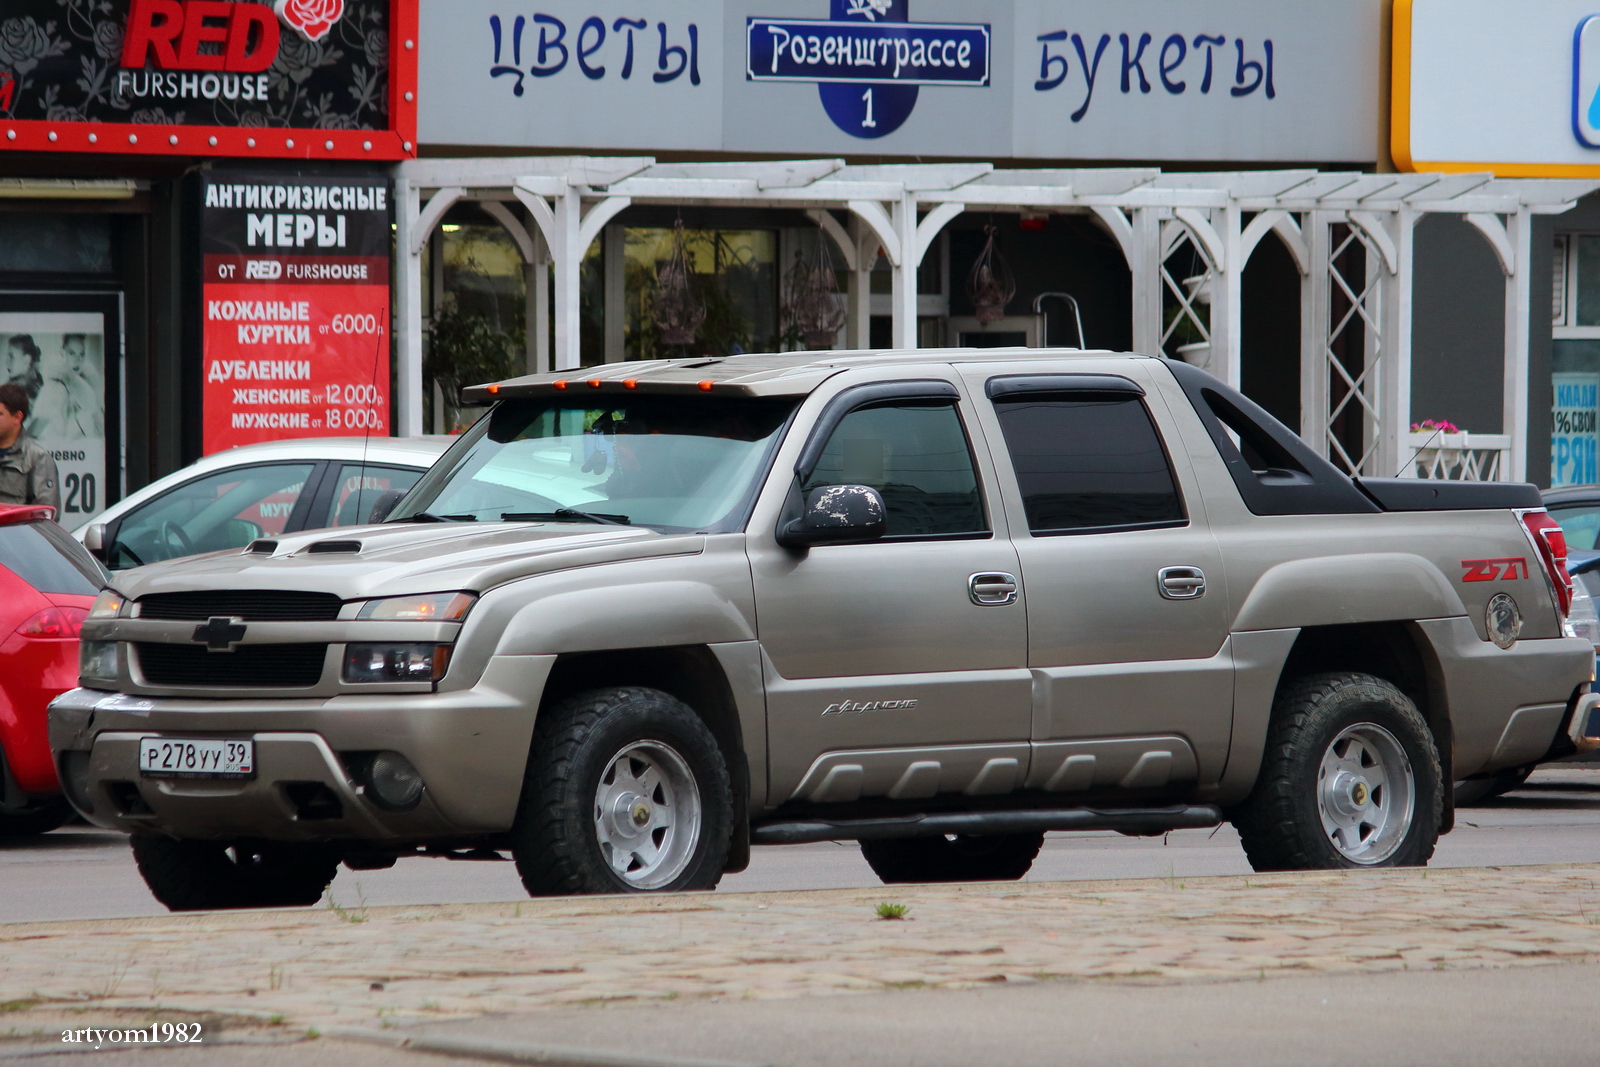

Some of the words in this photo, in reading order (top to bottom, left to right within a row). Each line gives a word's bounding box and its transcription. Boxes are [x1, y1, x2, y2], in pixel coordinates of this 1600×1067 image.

[120, 0, 280, 73] RED
[767, 25, 971, 78] Розенштрассе
[118, 71, 268, 100] FURSHOUSE
[1034, 30, 1275, 123] Букеты
[861, 87, 877, 128] 1
[205, 183, 387, 211] АНТИКРИЗИСНЫЕ
[247, 213, 347, 247] МЕРЫ
[245, 259, 282, 280] RED
[286, 264, 369, 280] FURSHOUSE
[208, 300, 310, 321] КОЖАНЫЕ
[237, 324, 311, 345] КУРТКИ
[331, 313, 376, 334] 6000
[207, 360, 311, 384] ДУБЛЕНКИ
[232, 388, 311, 405] ЖЕНСКИЕ
[231, 413, 310, 429] МУЖСКИЕ
[64, 472, 96, 513] 20
[1461, 557, 1529, 582] Z71
[821, 699, 918, 716] AVALANCHE
[225, 763, 240, 771] RUS
